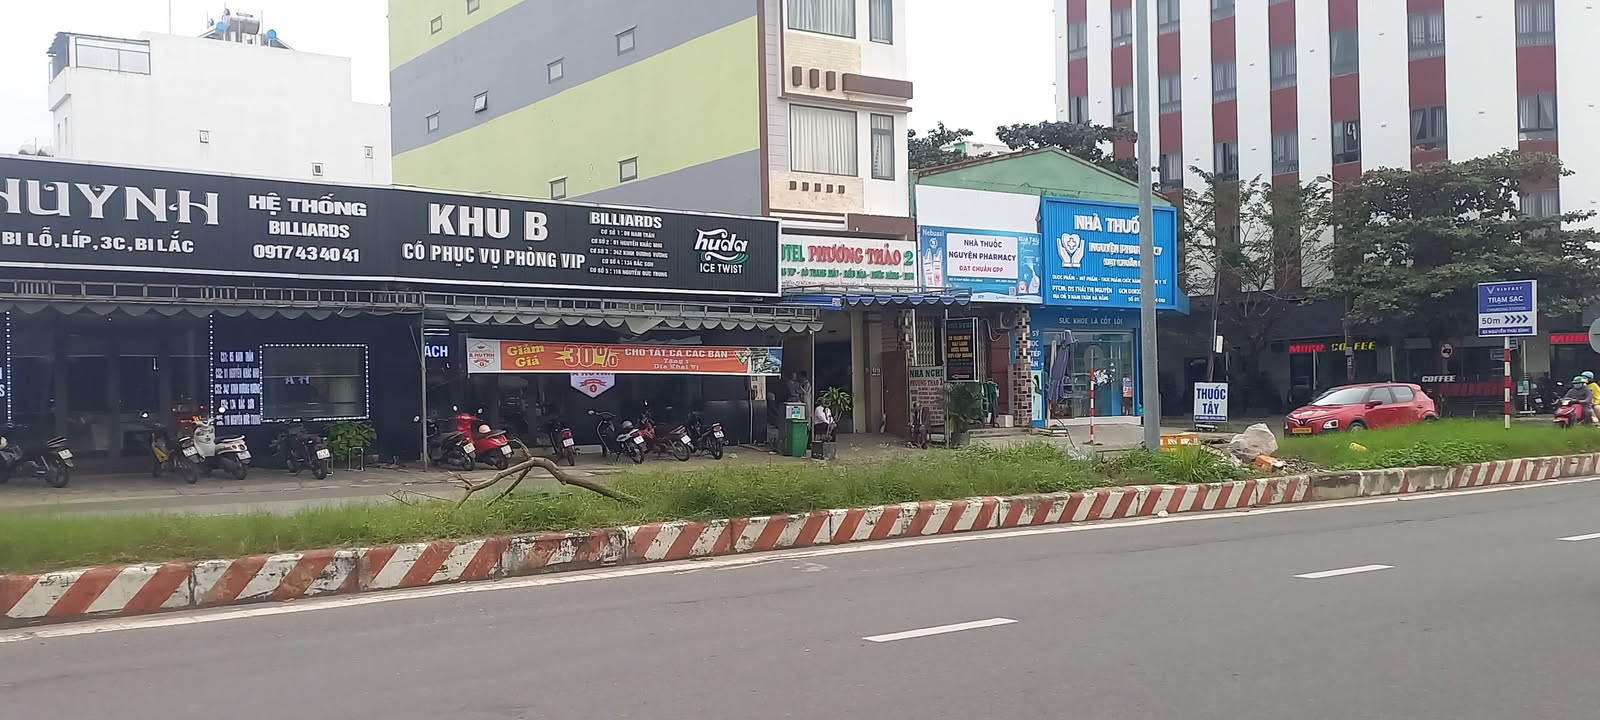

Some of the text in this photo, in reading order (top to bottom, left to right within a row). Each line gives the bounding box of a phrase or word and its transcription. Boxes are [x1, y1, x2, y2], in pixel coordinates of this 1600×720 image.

[249, 192, 367, 216] HỆ THỐNG
[429, 203, 548, 241] KHU B
[590, 212, 662, 229] BILLIARDS
[1074, 213, 1140, 234] NHÀ THUỐ
[269, 220, 350, 239] BILLIARDS
[2, 231, 22, 246] BI
[694, 228, 748, 252] huda
[964, 238, 1003, 248] NHÀ THUỐC
[253, 244, 360, 262] 0917 43 40 41
[402, 241, 586, 269] CÓ PHỤC VỤ PHÒNG VIP
[865, 242, 902, 266] THẢO
[903, 250, 914, 266] 2
[949, 251, 1017, 262] NGUYỆN PHARMACY
[700, 263, 743, 274] ICE TWIST
[1488, 295, 1524, 304] TRẠM SẠC
[1481, 317, 1501, 325] 50m
[624, 348, 646, 356] CHO
[1332, 341, 1376, 351] COFEE
[515, 355, 540, 367] Giá
[563, 344, 620, 368] 30%
[1421, 374, 1457, 383] COFFEE
[1196, 384, 1226, 400] THUỐC
[1202, 400, 1220, 415] TÂY
